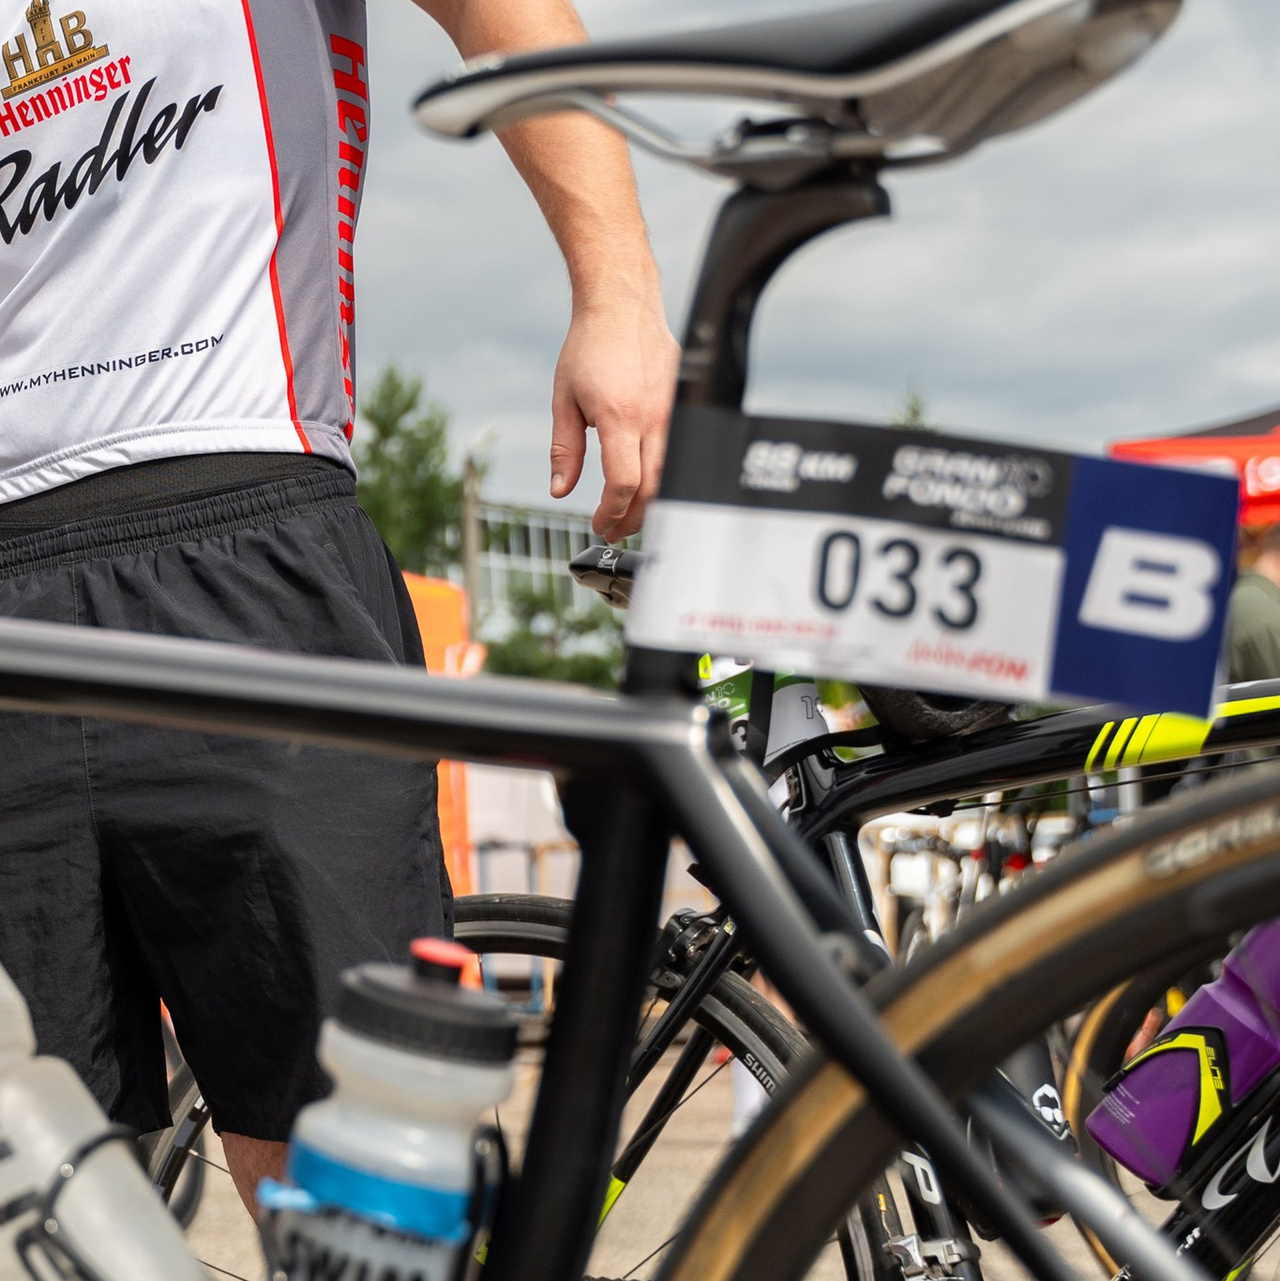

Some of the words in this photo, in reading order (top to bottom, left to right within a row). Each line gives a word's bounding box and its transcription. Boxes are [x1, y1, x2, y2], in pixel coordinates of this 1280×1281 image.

[12, 68, 61, 93] FRANKFURT
[62, 62, 75, 72] AM
[76, 51, 97, 65] MAIN
[816, 530, 983, 631] 033
[1077, 524, 1222, 642] B
[743, 1053, 780, 1096] SHIM
